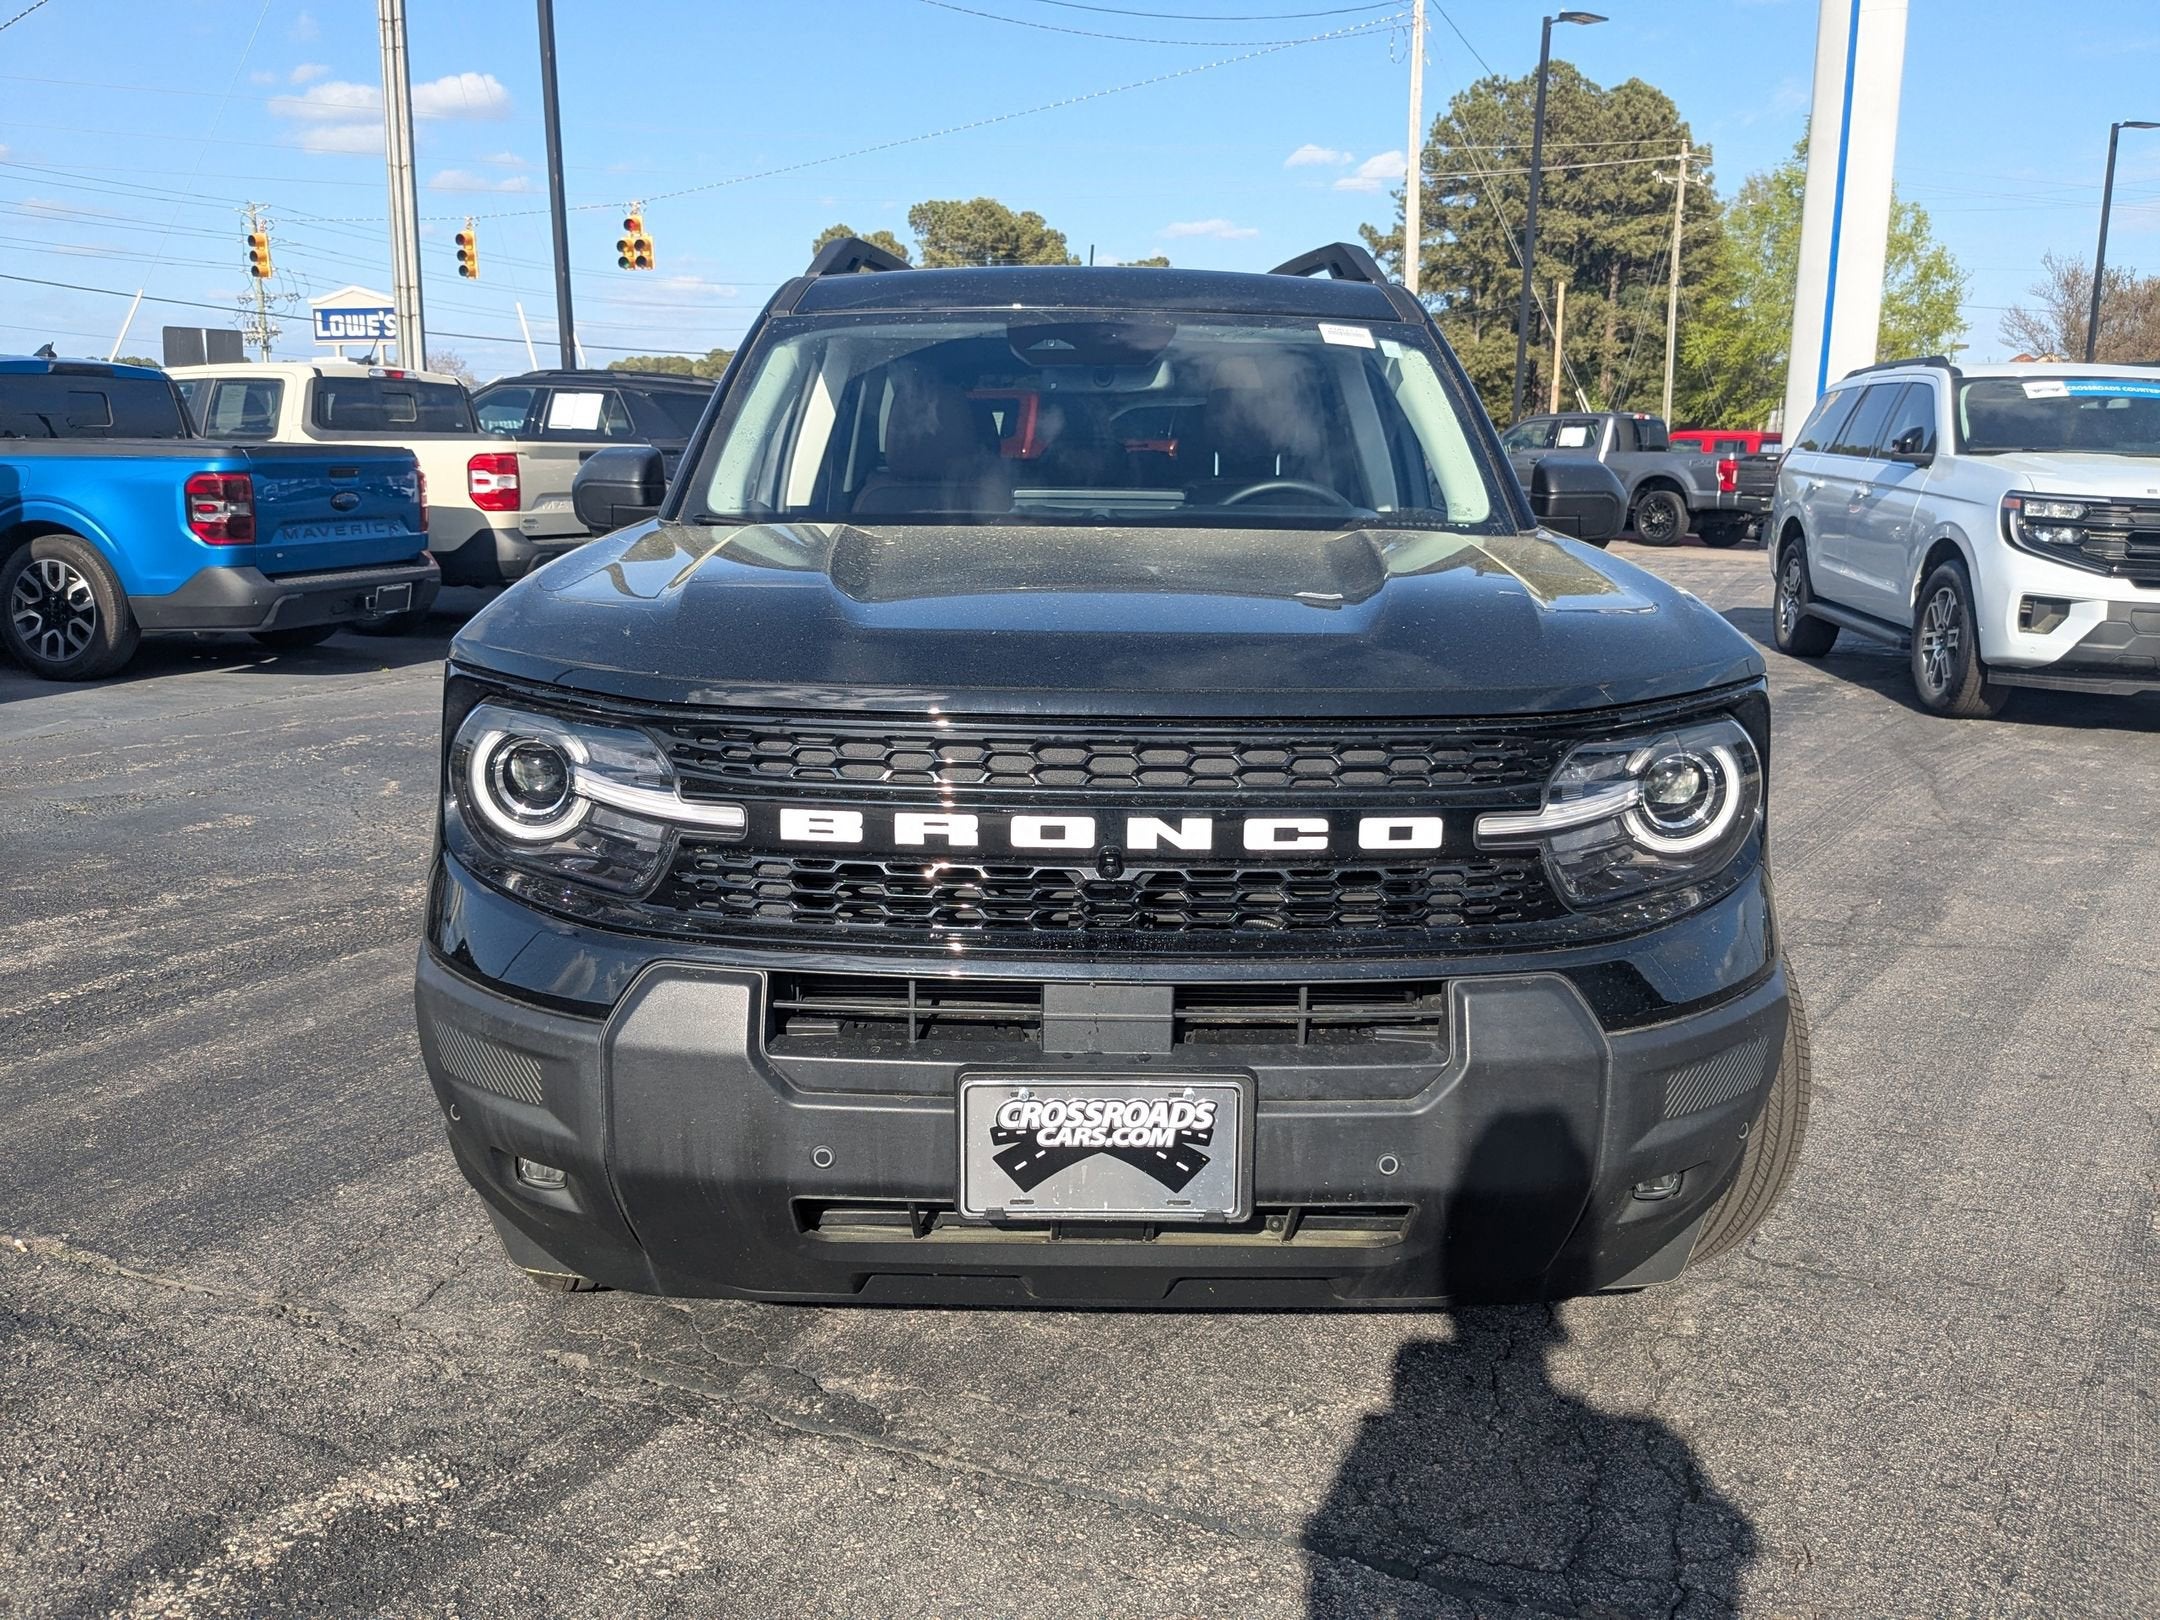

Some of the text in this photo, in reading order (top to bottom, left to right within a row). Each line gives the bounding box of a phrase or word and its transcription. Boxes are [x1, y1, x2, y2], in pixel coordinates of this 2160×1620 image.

[315, 311, 397, 336] LOWE'S
[281, 520, 401, 541] MAVERICK
[779, 808, 1444, 850] BRONCO
[997, 1100, 1217, 1130] CROSSROADS
[1036, 1127, 1177, 1148] CARS.COM
